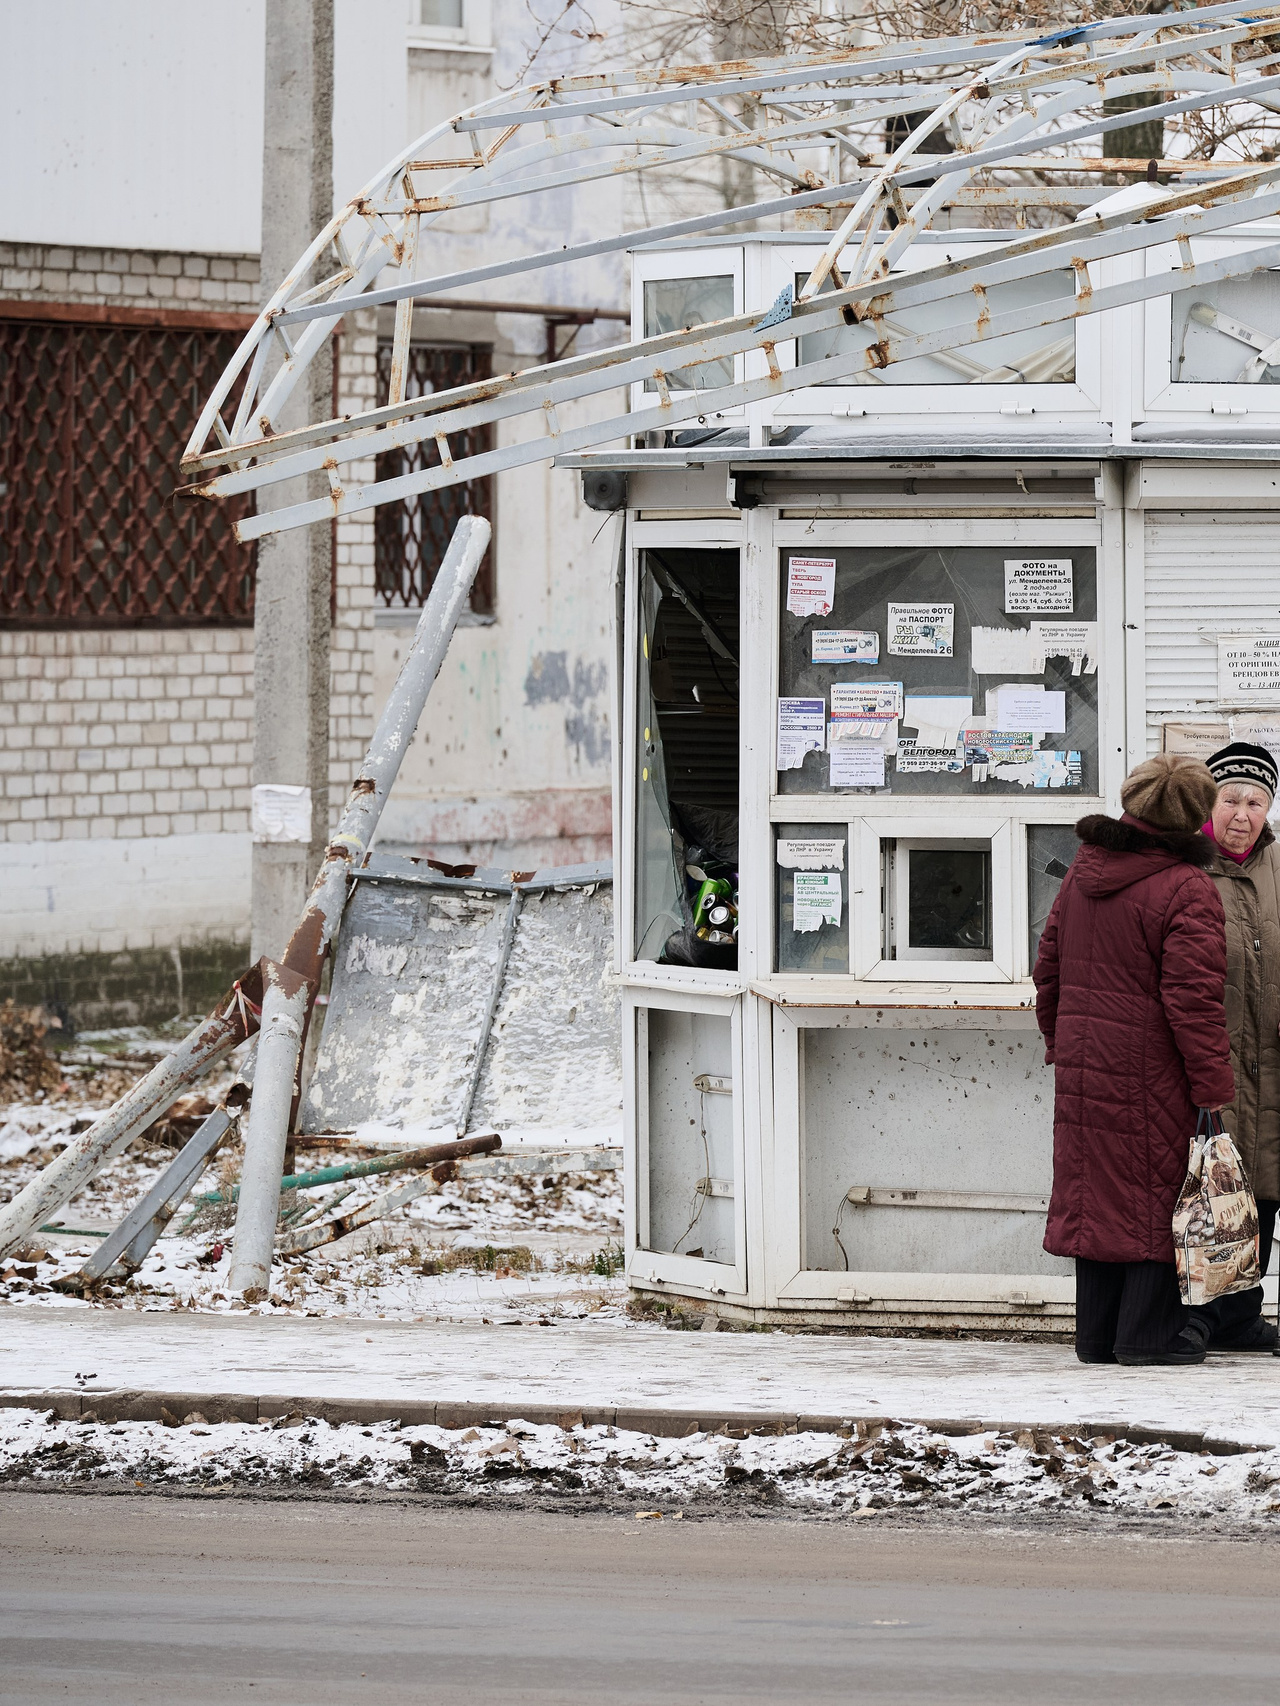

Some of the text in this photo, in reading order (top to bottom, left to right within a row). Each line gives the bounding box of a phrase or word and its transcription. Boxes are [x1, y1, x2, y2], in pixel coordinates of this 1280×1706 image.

[891, 606, 930, 615] Правильное
[896, 625, 914, 635] РЫ
[891, 635, 920, 645] ЖИК
[1253, 640, 1280, 648] АКЦИЯ
[898, 646, 938, 655] Менделеева
[939, 645, 953, 654] 26
[1184, 733, 1211, 741] Требуется
[903, 748, 957, 757] БЕЛГОРОД
